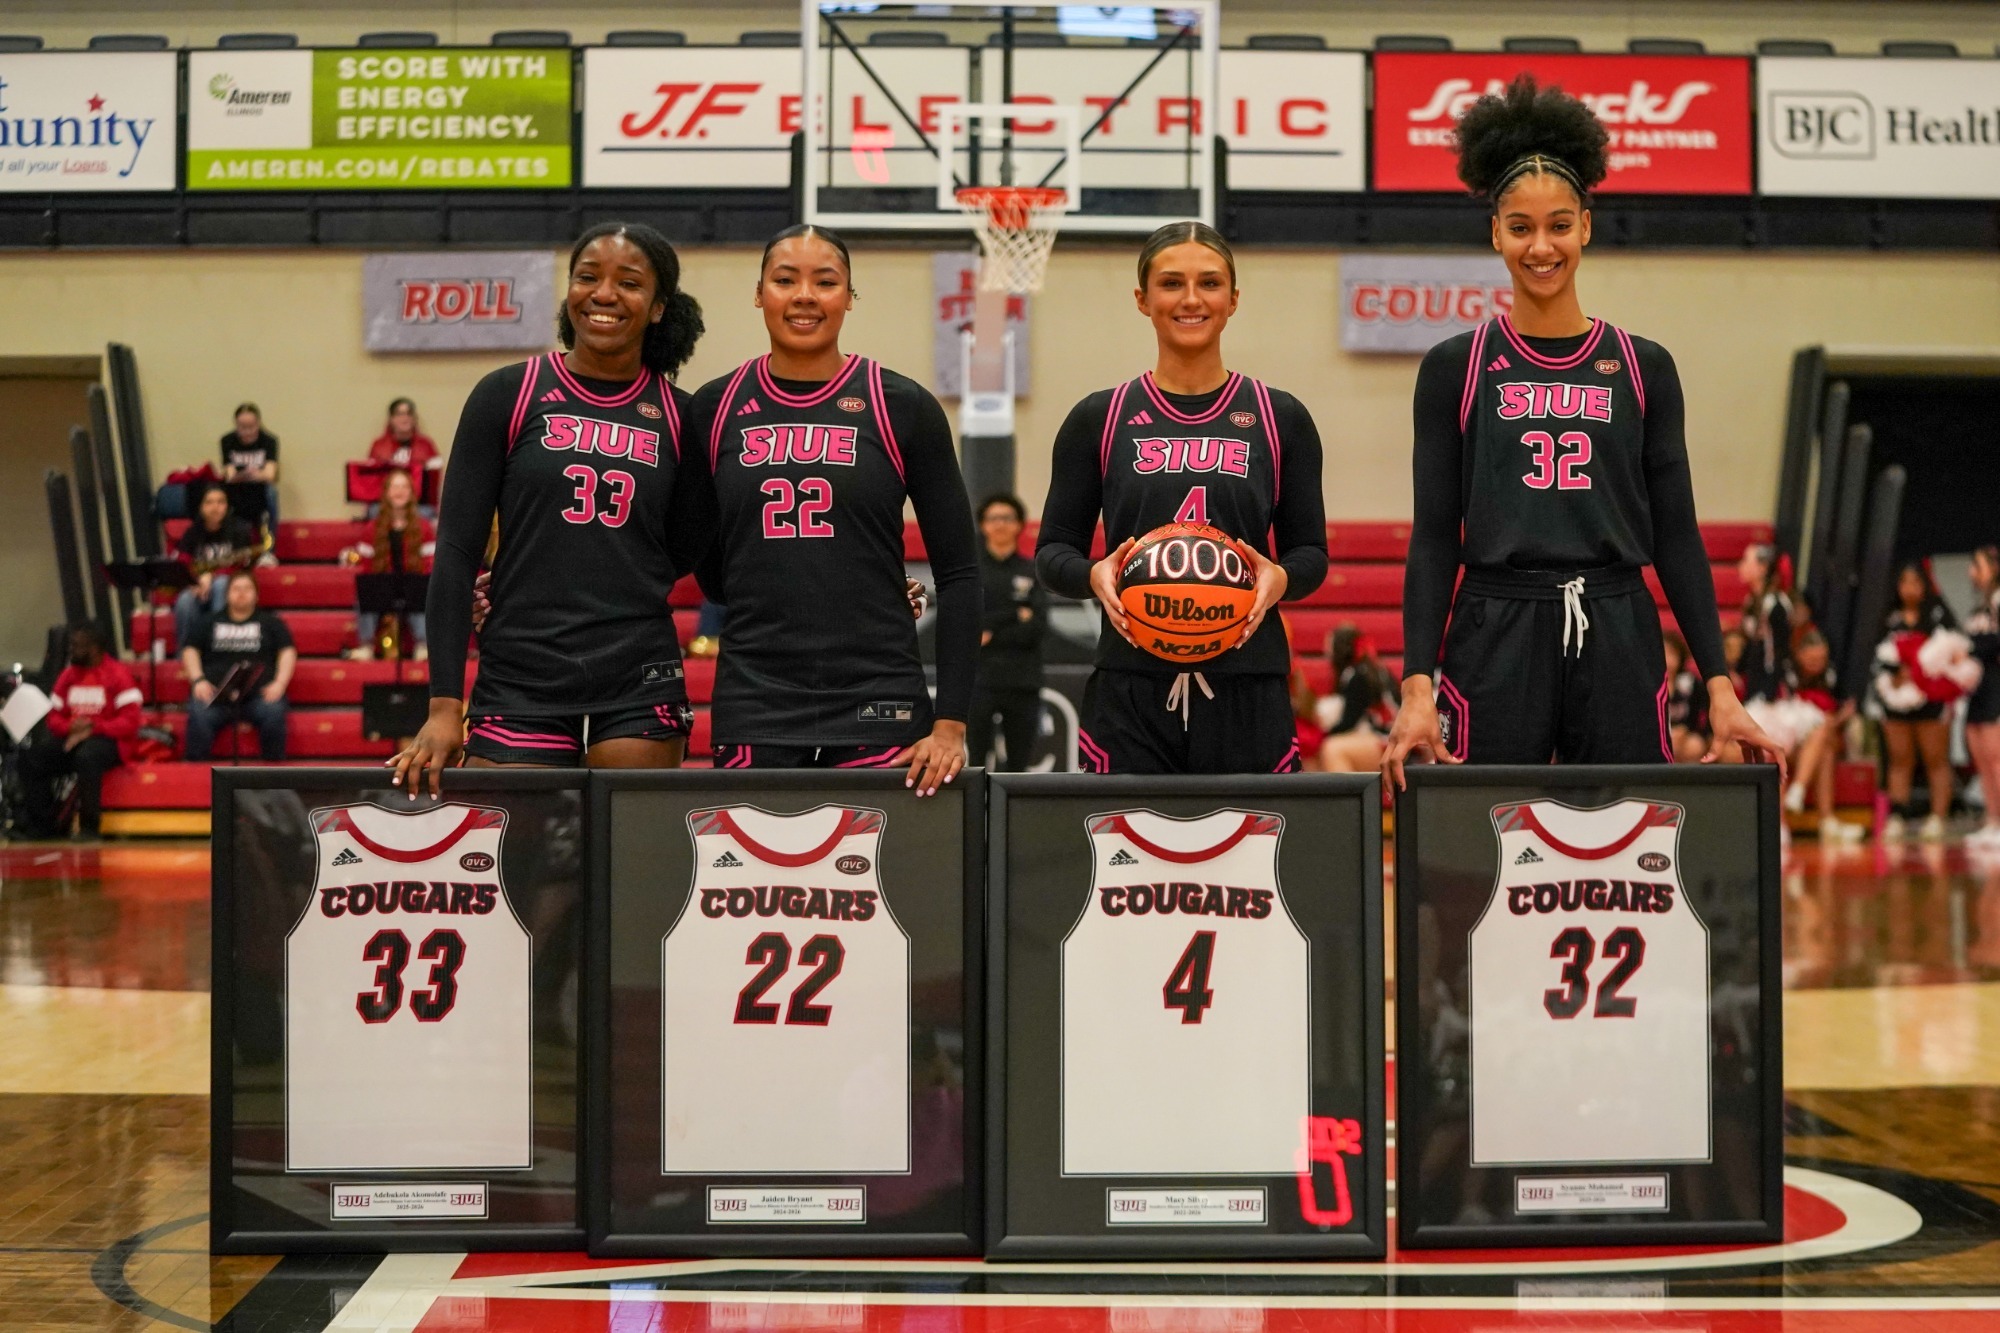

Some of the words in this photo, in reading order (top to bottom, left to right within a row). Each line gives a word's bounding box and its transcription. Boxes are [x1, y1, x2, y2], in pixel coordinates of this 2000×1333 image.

[337, 55, 449, 80] SCORE
[458, 55, 547, 80] WITH
[228, 88, 292, 105] Ameren
[337, 85, 469, 110] ENERGY
[337, 114, 539, 140] EFFICIENCY.
[1624, 129, 1718, 149] PARTNER
[1785, 104, 1863, 152] BJC
[1885, 105, 2000, 145] Healt
[28, 160, 60, 175] your
[62, 158, 108, 175] Loans
[206, 155, 551, 182] AMEREN.COM/REBATES
[402, 280, 521, 321] ROLL
[1352, 283, 1513, 323] COUGS
[1496, 382, 1612, 423] SIUE
[541, 414, 660, 468] SIUE
[739, 424, 858, 467] SIUE
[1132, 436, 1250, 478] SIUE
[1520, 431, 1592, 490] 32
[561, 464, 635, 528] 33
[760, 477, 834, 539] 22
[1173, 486, 1211, 525] 4
[1145, 539, 1243, 583] 1000
[1144, 592, 1235, 621] Wilson
[1152, 638, 1222, 656] NCAA
[331, 857, 363, 867] adidas
[712, 859, 744, 868] adidas
[1109, 857, 1139, 866] adidas
[1514, 856, 1544, 866] adidas
[319, 880, 499, 918] COUGARS
[700, 885, 878, 921] COUGARS
[1098, 882, 1274, 920] COUGARS
[1506, 878, 1675, 916] COUGARS
[355, 928, 467, 1024] 33
[733, 931, 846, 1026] 22
[1162, 930, 1217, 1025] 4
[1543, 926, 1646, 1020] 32
[338, 1194, 370, 1207] SIUE
[451, 1193, 482, 1206] SIUE
[715, 1199, 747, 1211] SIUE
[788, 1196, 813, 1204] Bryant
[828, 1198, 860, 1211] SIUE
[1114, 1199, 1147, 1212] SIUE
[1228, 1199, 1261, 1212] SIUE
[1521, 1186, 1554, 1200] SIUE
[1631, 1185, 1663, 1198] SIUE
